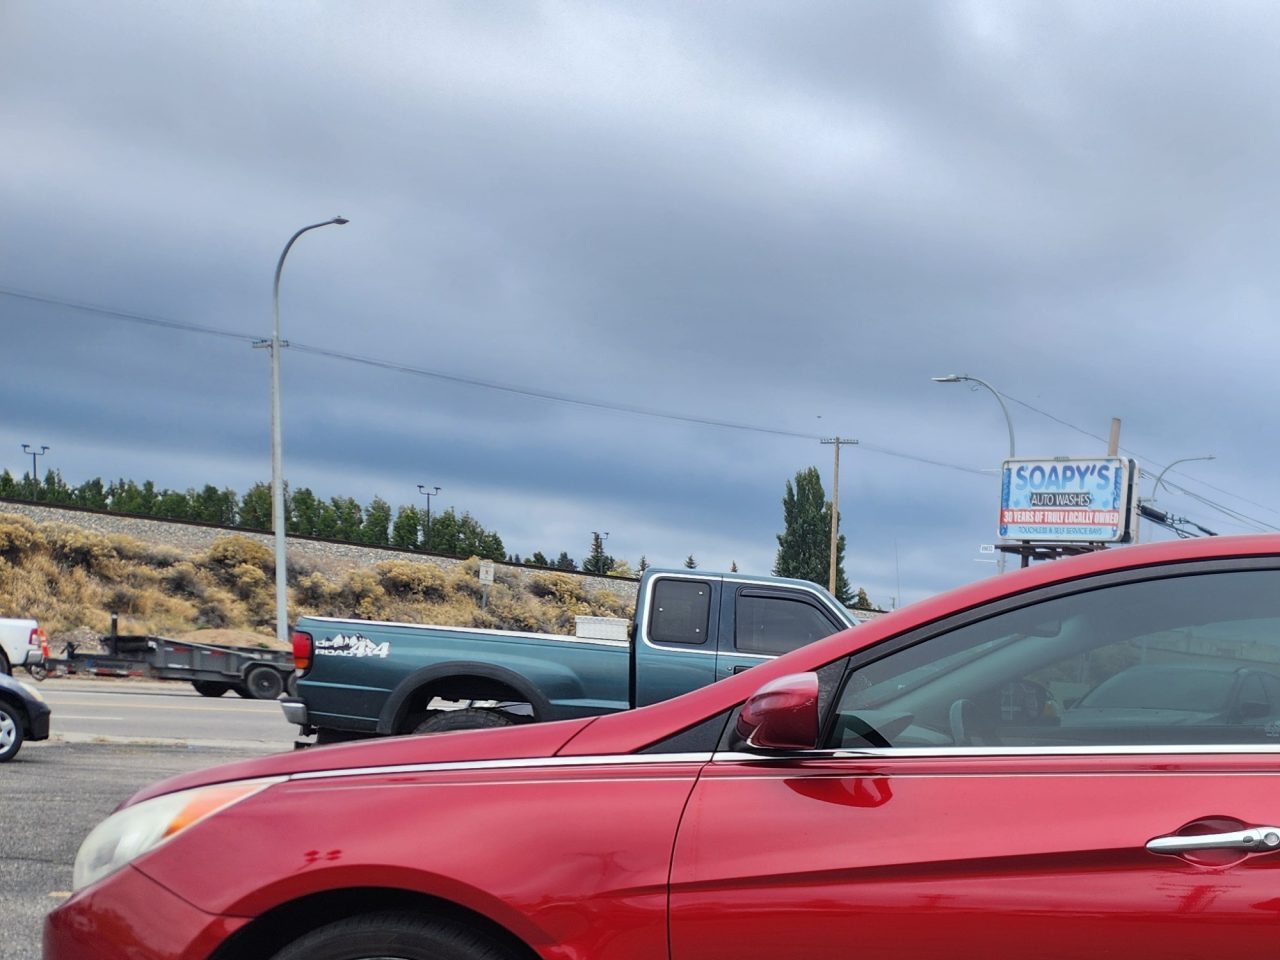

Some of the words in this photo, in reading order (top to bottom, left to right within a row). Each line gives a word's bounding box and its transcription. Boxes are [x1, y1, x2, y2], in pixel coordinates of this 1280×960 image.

[1014, 463, 1111, 491] SOAPY'S
[1031, 494, 1054, 506] AUTO
[1056, 494, 1090, 506] WASHES
[1004, 511, 1013, 522] 30
[1014, 511, 1034, 522] YEARS
[1035, 511, 1044, 522] OF
[1045, 511, 1064, 523] TRULY
[1065, 512, 1093, 523] LOCALLY
[1094, 512, 1119, 524] OWNED
